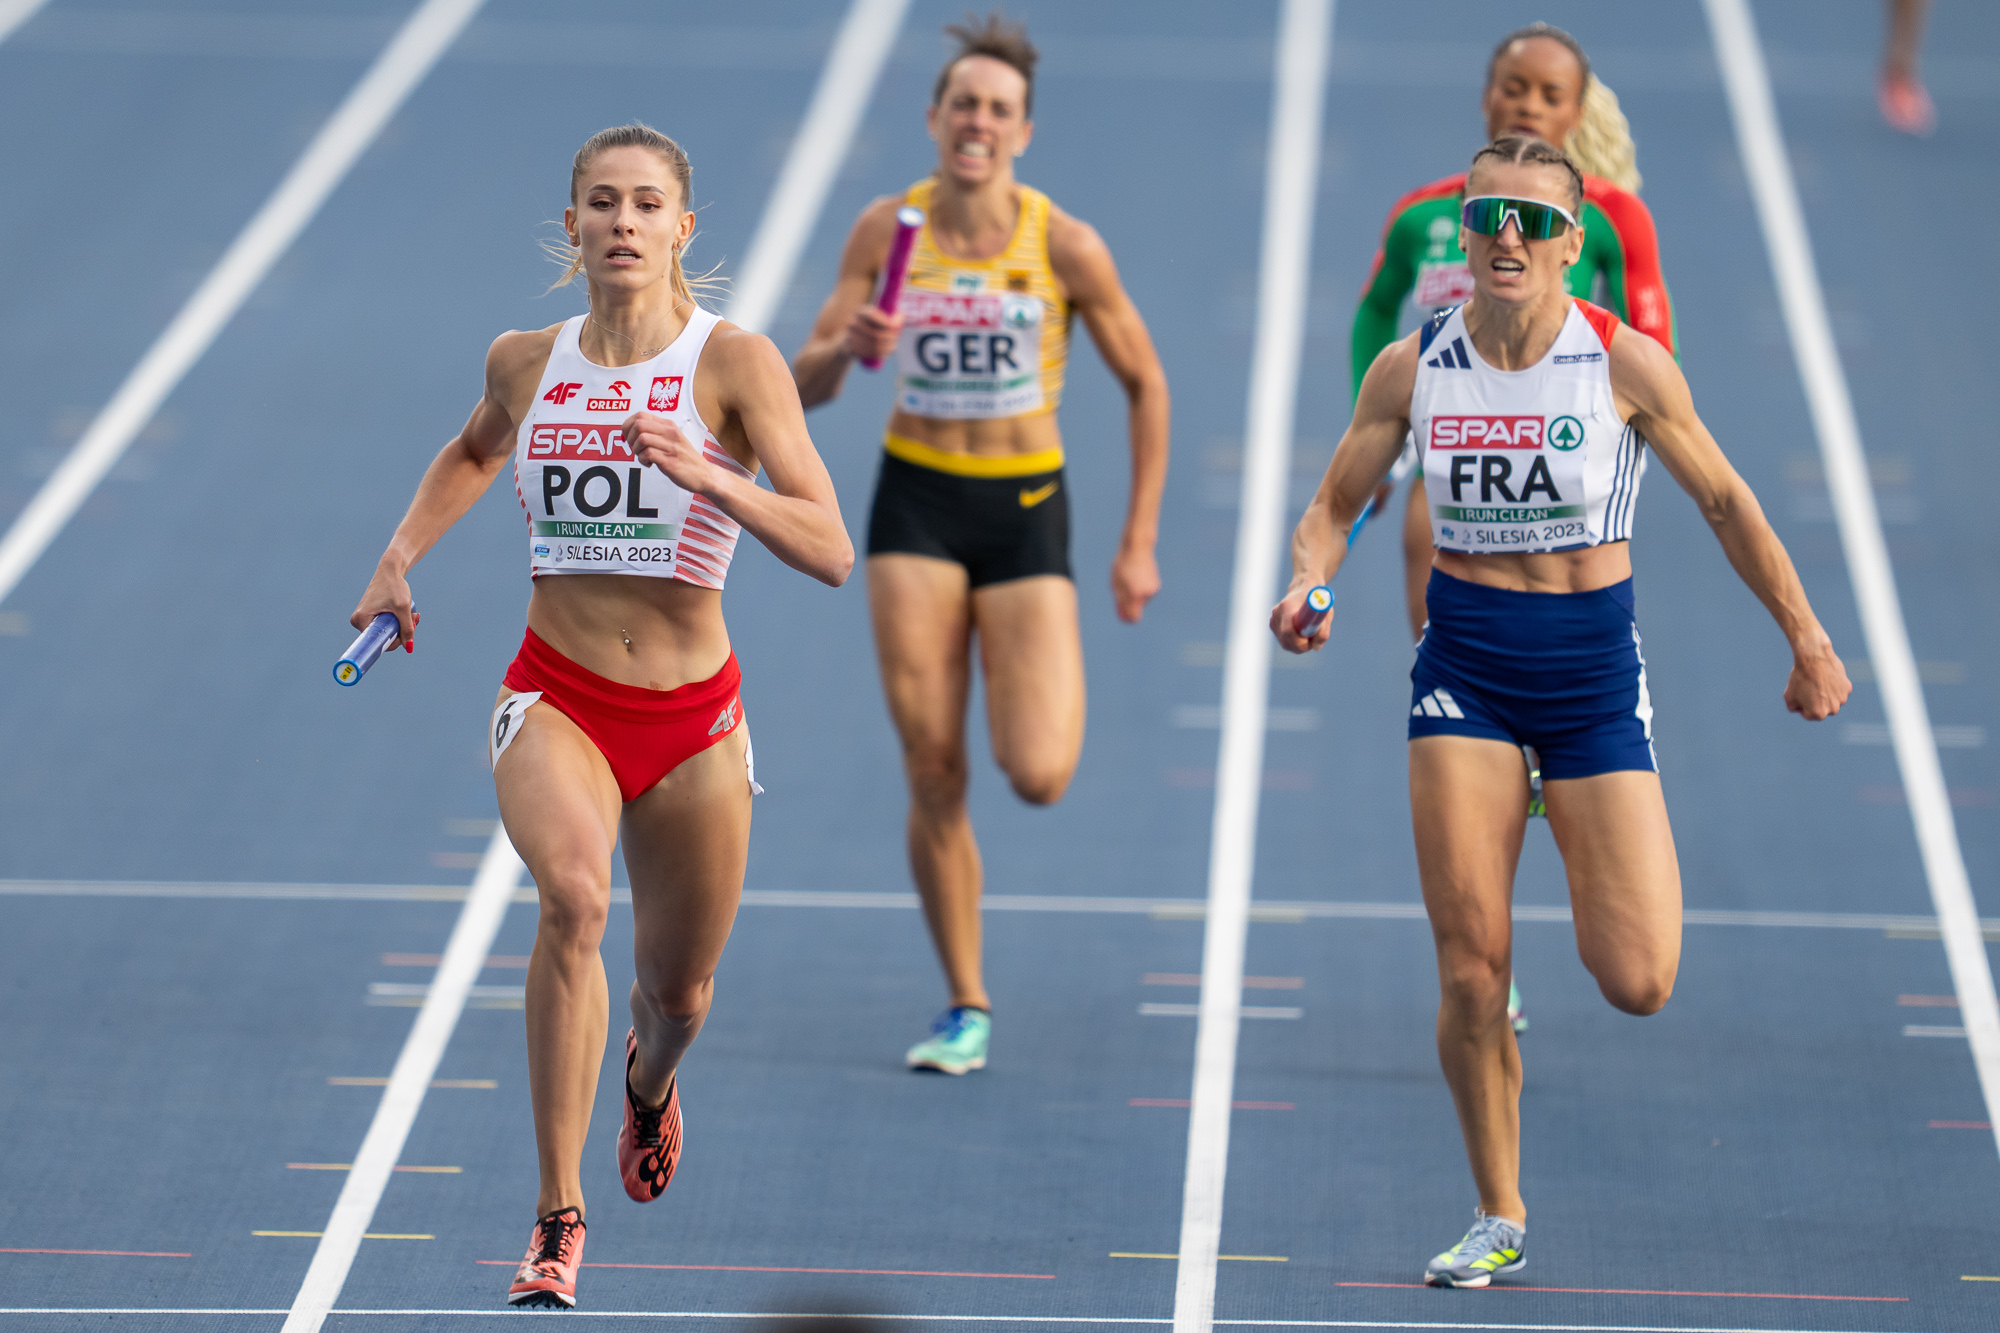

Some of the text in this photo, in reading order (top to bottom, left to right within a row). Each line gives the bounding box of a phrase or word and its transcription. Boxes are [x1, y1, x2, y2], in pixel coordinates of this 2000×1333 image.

[915, 332, 1019, 374] GER
[543, 381, 584, 405] 4F
[589, 400, 629, 410] ORLEN
[1433, 419, 1541, 446] SPAR
[1450, 455, 1563, 503] FRA
[542, 465, 659, 519] POL
[1466, 509, 1498, 522] RUN
[561, 524, 585, 537] RUN
[1476, 522, 1585, 545] SILESIA 2023
[566, 545, 672, 563] SILESIA 2023
[495, 701, 518, 749] 6
